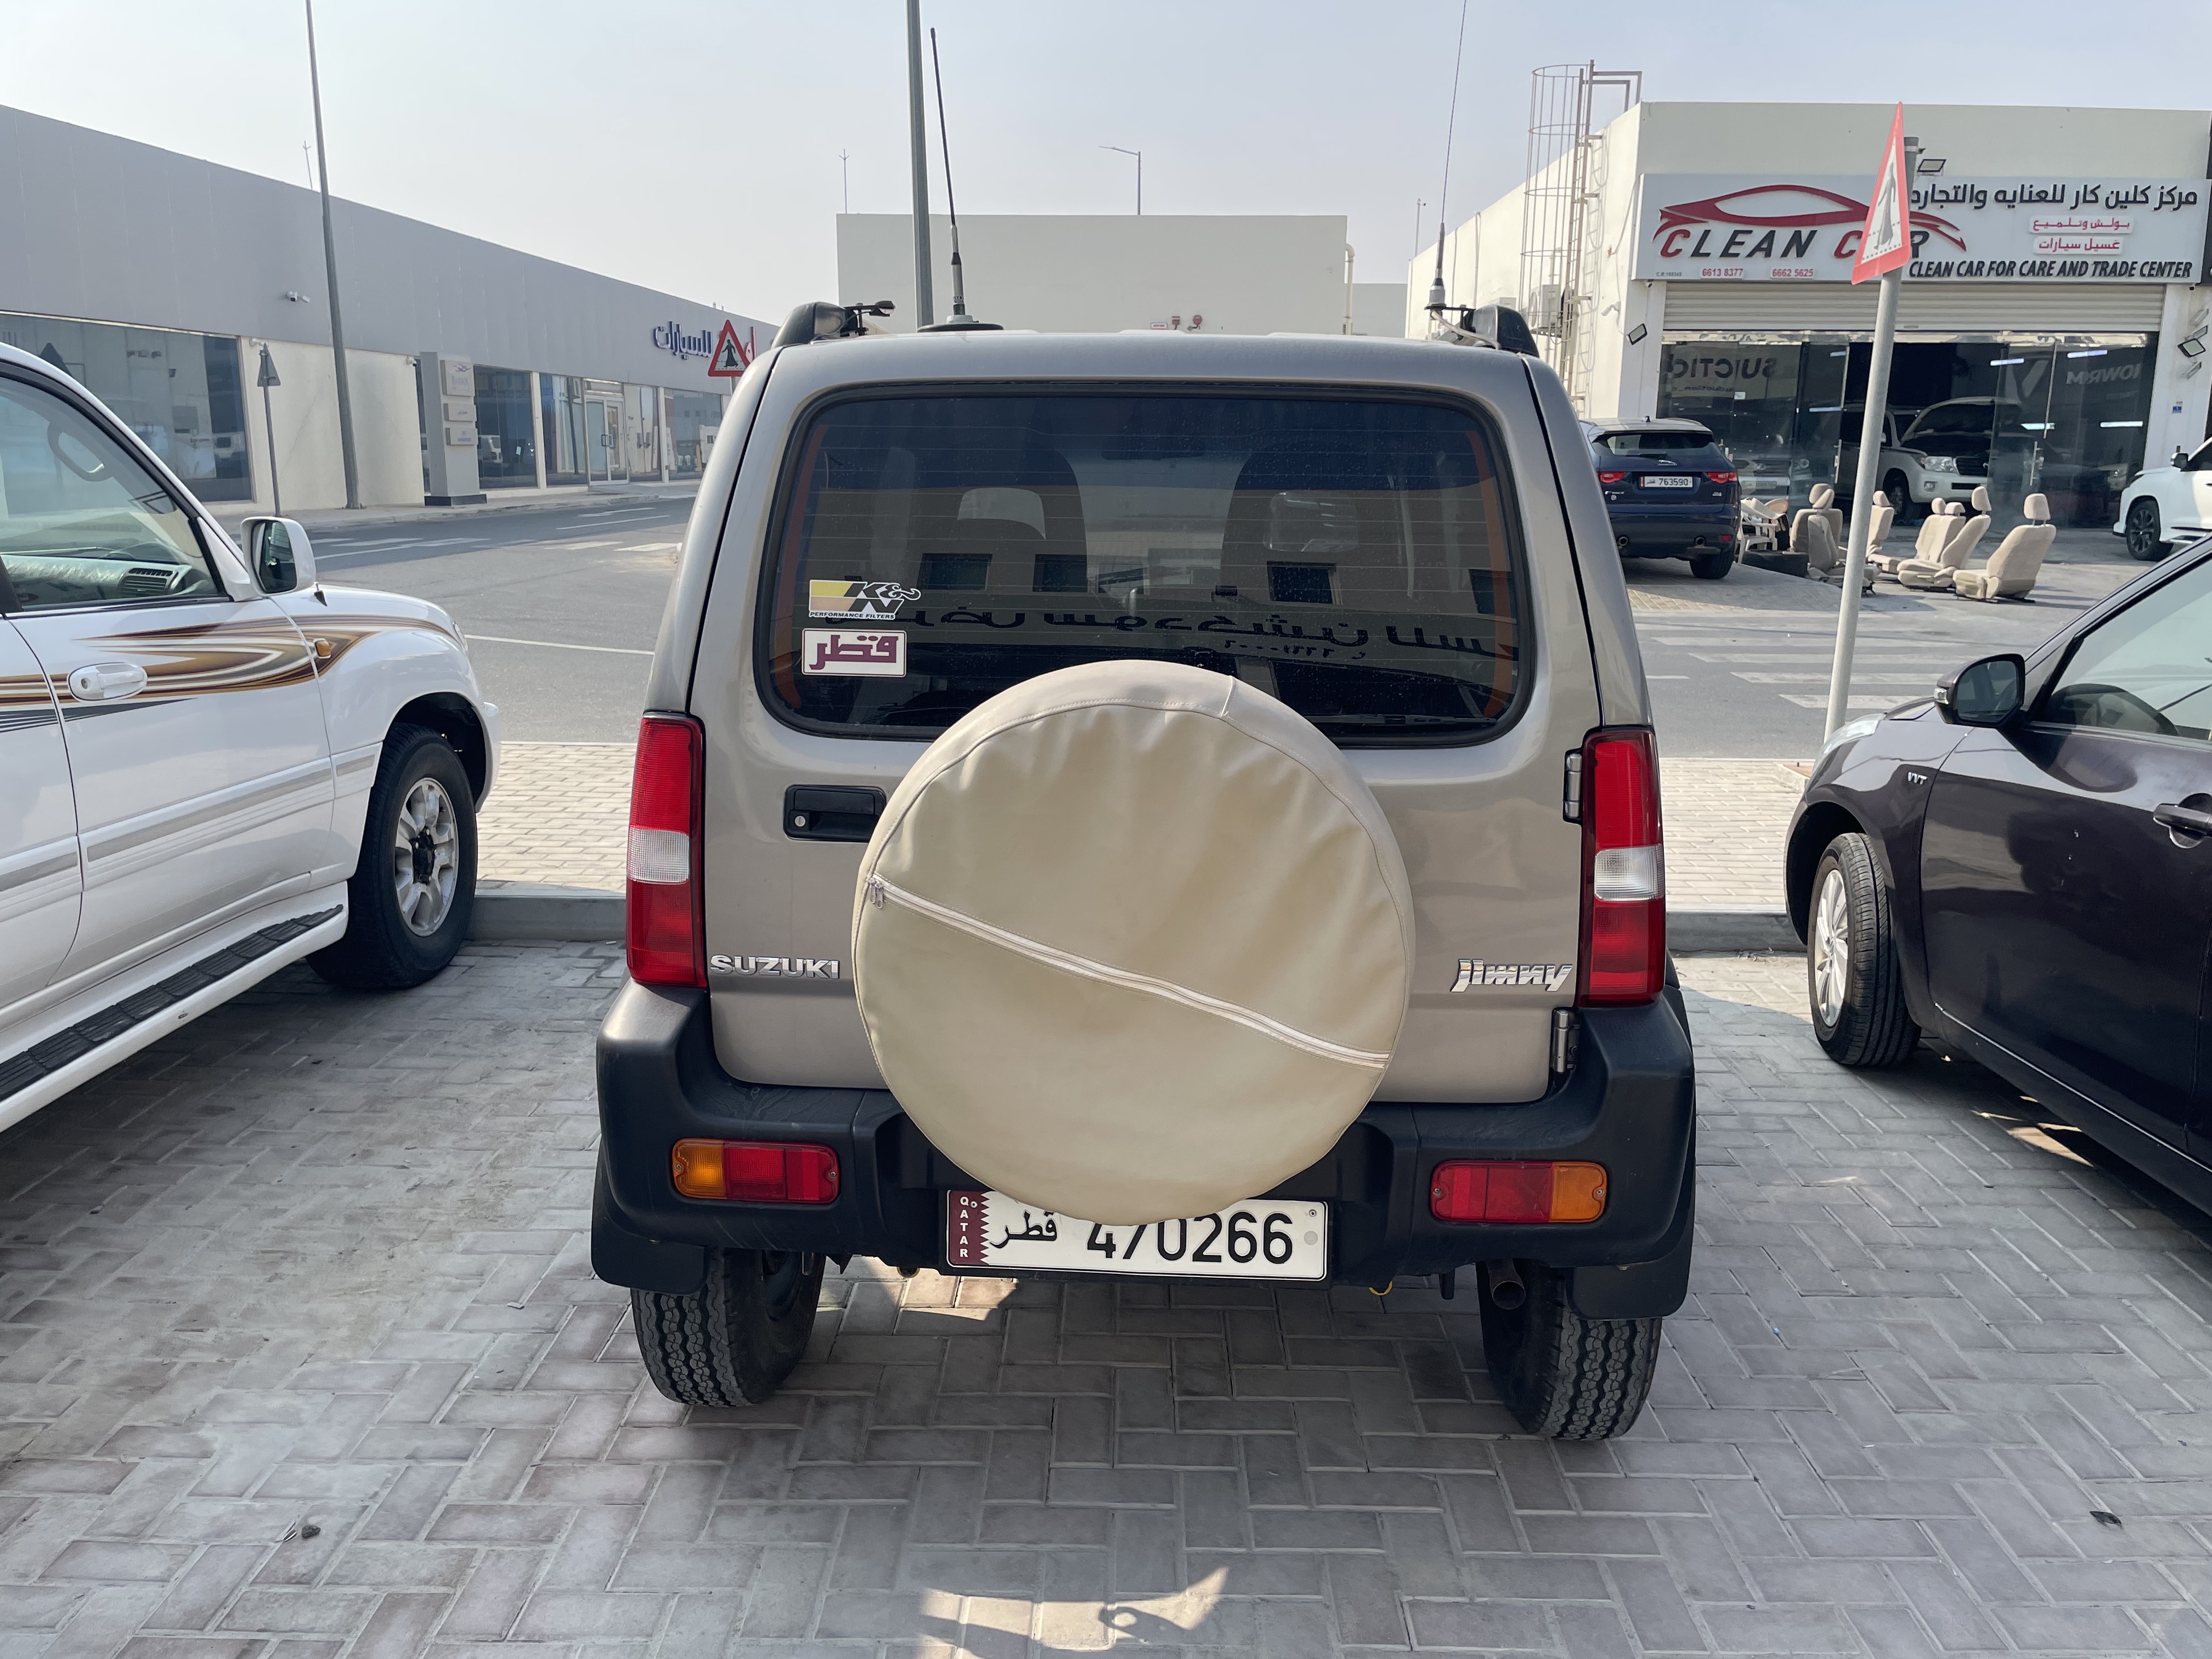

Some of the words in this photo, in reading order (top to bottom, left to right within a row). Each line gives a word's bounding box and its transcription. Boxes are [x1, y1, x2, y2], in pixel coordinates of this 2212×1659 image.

[2069, 184, 2101, 210] كار
[2105, 184, 2151, 210] كلين
[2152, 185, 2197, 211] مركز
[1660, 229, 1818, 258] CLEAN
[1834, 230, 1929, 258] CR
[2039, 238, 2081, 252] سيارات
[2085, 238, 2120, 251] غسيل
[1702, 268, 1722, 277] 6613
[1724, 268, 1744, 277] 8377
[1772, 268, 1792, 277] 6662
[1795, 268, 1814, 277] 5625
[1909, 261, 1954, 277] CLEAN
[1957, 261, 1985, 276] CAR
[1986, 261, 2017, 277] FOR
[2019, 261, 2056, 277] CARE
[2056, 261, 2089, 277] AND
[2091, 261, 2138, 277] TRADE
[2140, 261, 2193, 278] CENTER
[1658, 478, 1689, 486] 763590
[843, 583, 921, 613] K&N
[809, 635, 899, 670] قطر
[710, 955, 840, 979] SUZUKI
[960, 1197, 969, 1257] QATAR
[990, 1211, 1057, 1249] قطر
